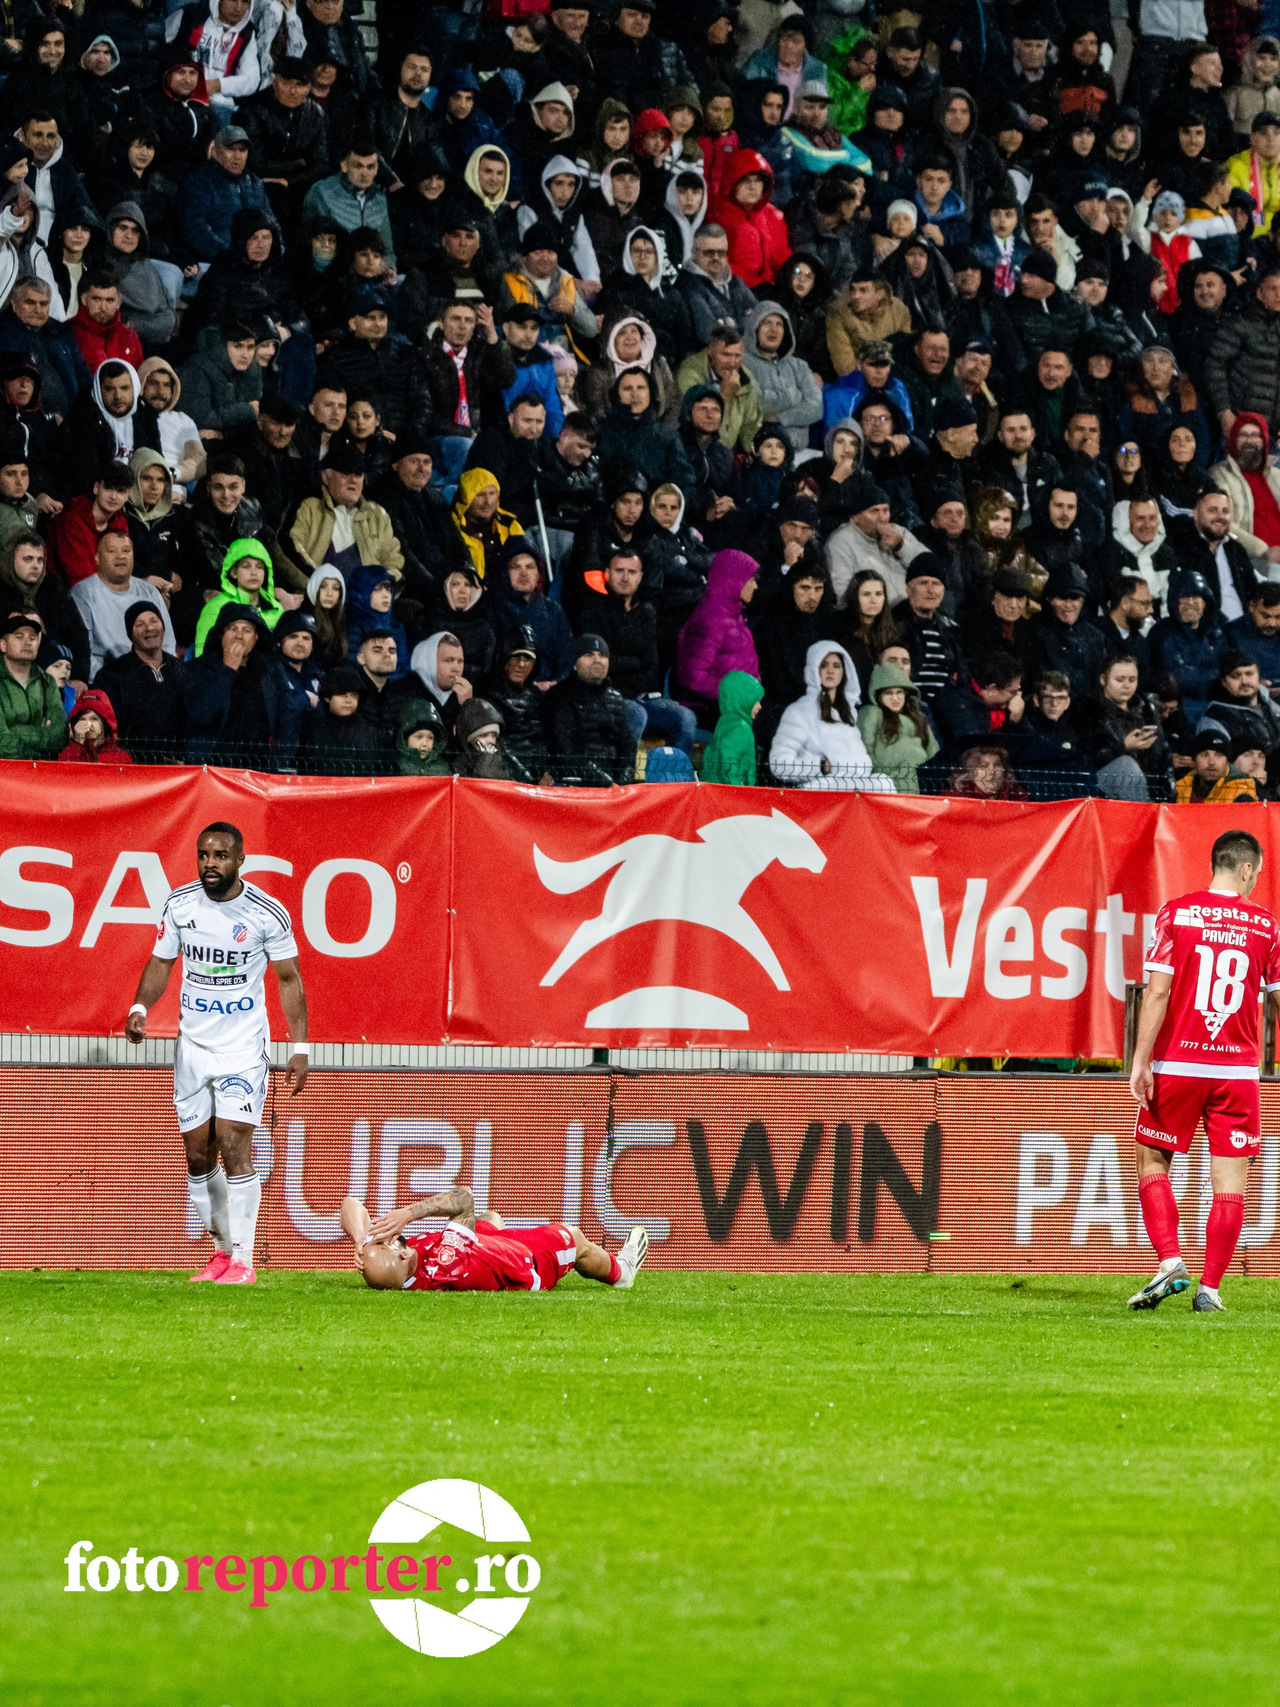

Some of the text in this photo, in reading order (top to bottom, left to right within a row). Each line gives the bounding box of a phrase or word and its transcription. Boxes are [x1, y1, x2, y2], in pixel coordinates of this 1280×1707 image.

[1189, 905, 1272, 928] Regata.ro
[910, 876, 1265, 1002] Vest
[1202, 929, 1247, 947] PAVIČIĆ
[1194, 944, 1250, 1014] 18
[182, 992, 255, 1015] ELSACO
[1179, 1040, 1242, 1053] 7777 GAMING
[1137, 1124, 1178, 1144] CARPATINA
